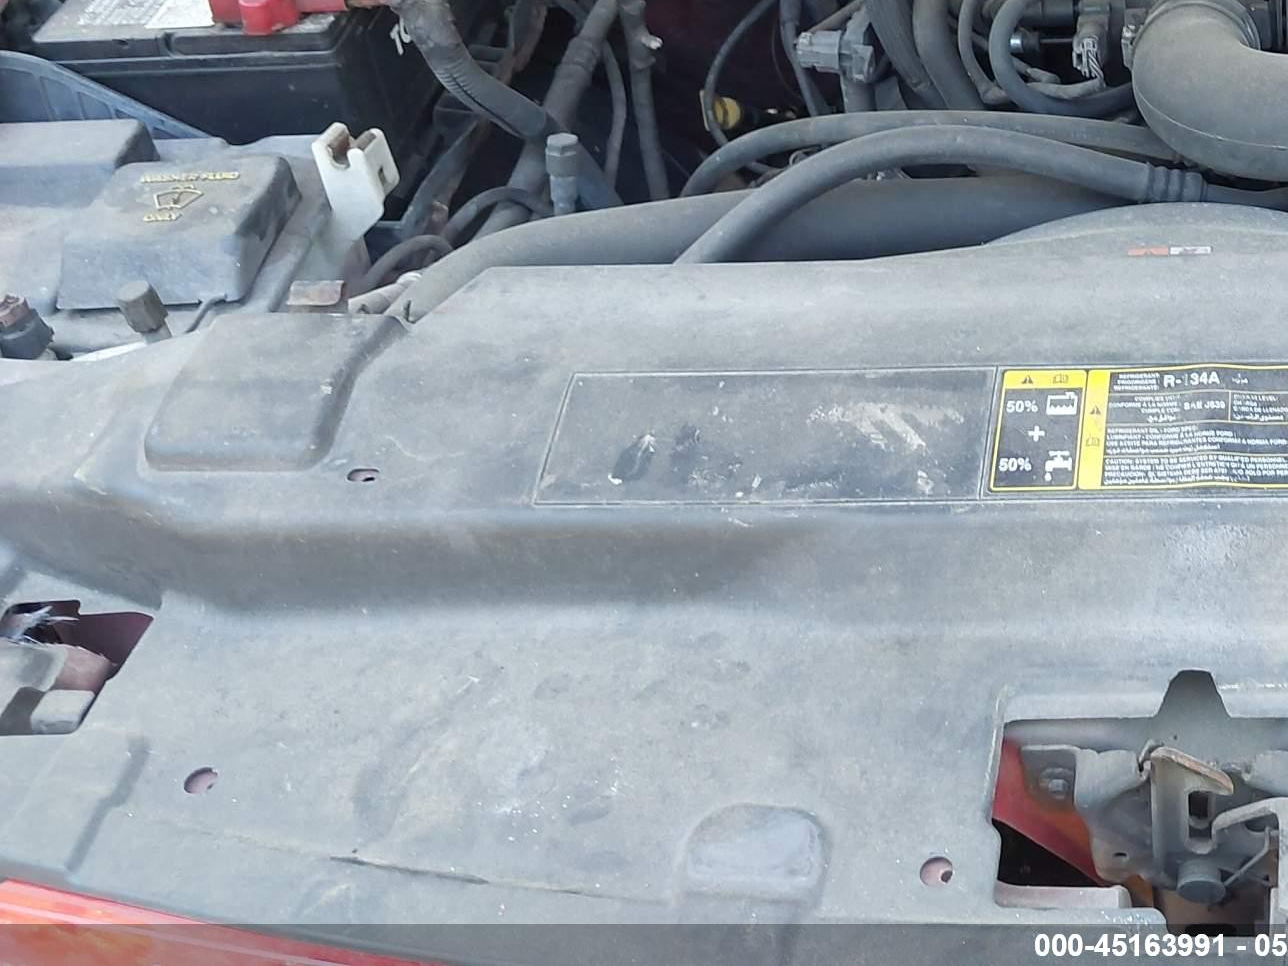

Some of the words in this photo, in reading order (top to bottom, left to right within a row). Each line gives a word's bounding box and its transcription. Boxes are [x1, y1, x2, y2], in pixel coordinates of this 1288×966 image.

[200, 171, 241, 182] FLUID
[1006, 400, 1039, 413] 50%
[998, 457, 1033, 472] 50%
